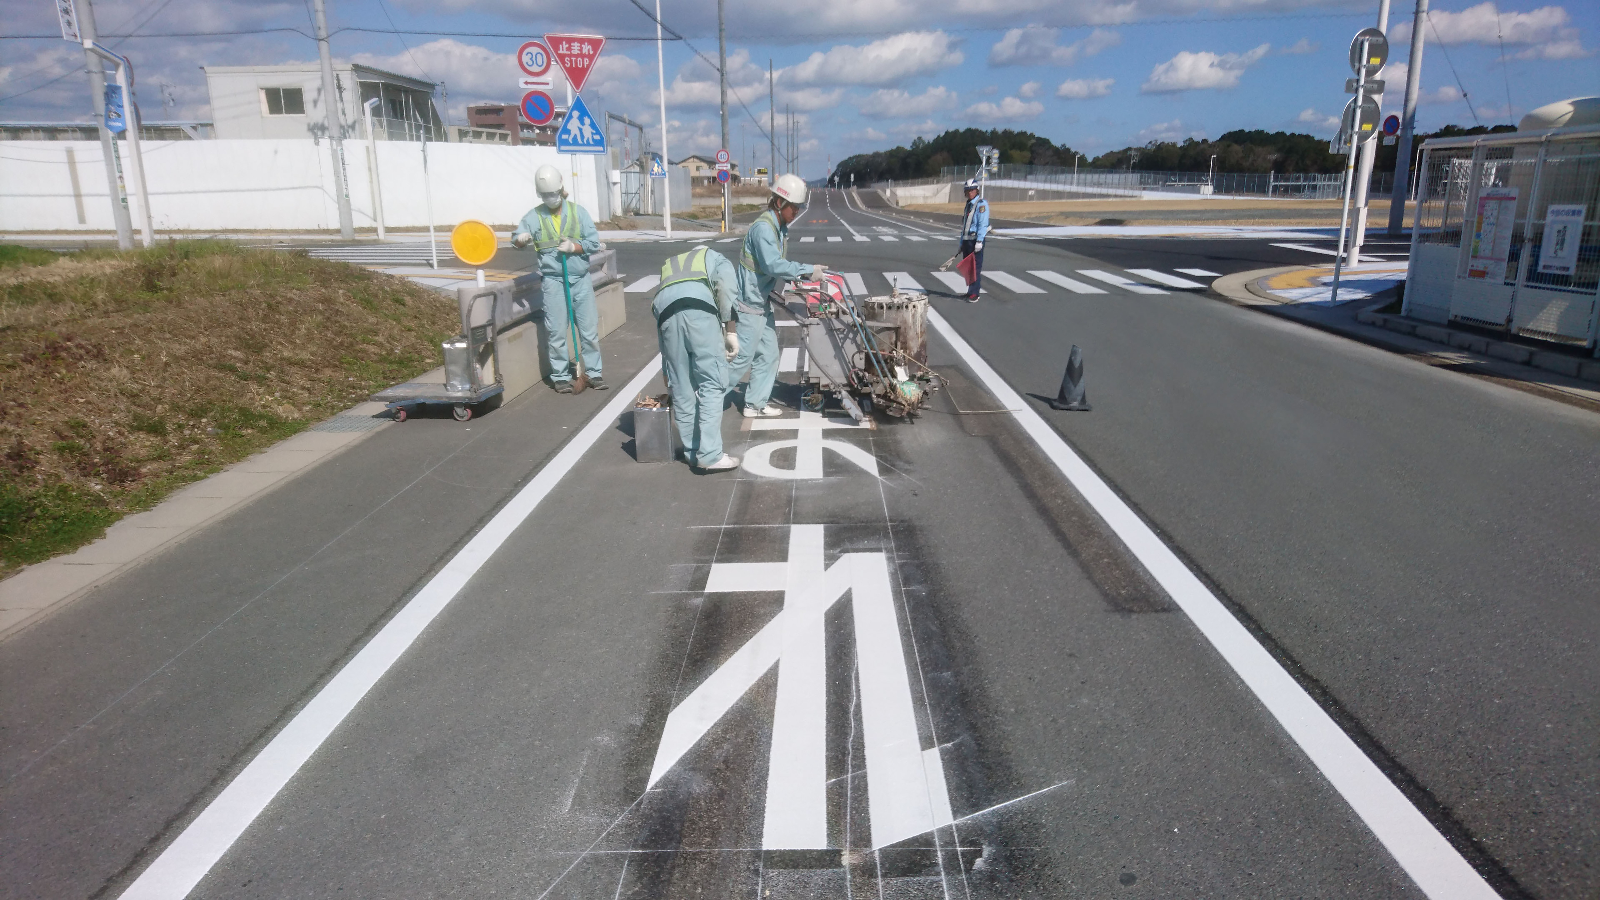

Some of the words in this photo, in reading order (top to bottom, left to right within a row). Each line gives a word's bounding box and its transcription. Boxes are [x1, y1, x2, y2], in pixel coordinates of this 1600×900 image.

[558, 41, 594, 55] 止まれ
[525, 51, 545, 68] 30
[564, 57, 590, 69] STOP
[718, 153, 727, 161] 40
